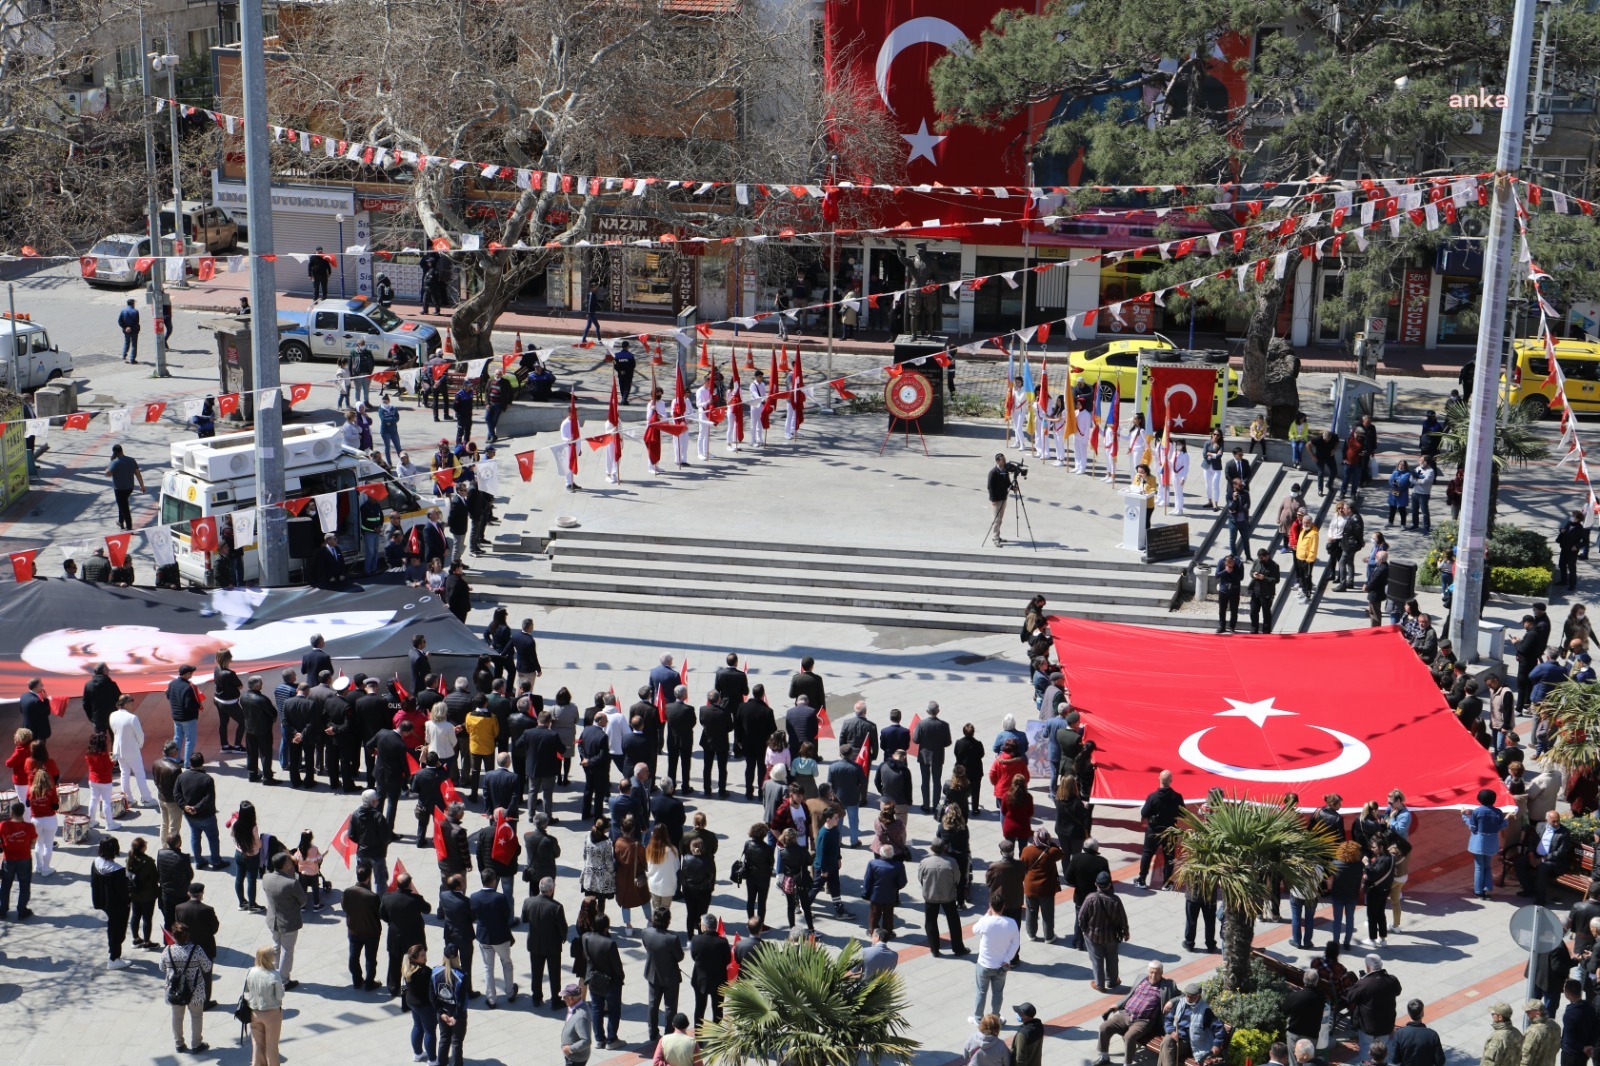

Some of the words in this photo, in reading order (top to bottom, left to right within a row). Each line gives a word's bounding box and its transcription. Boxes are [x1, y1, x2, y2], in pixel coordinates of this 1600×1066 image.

[271, 195, 349, 210] UYUMCULUK
[599, 217, 648, 232] NAZAR
[1409, 273, 1428, 282] SEMA
[681, 261, 692, 310] KUYUMCUL
[1132, 305, 1140, 315] 9
[1405, 283, 1425, 342] KUYMCULUK
[345, 342, 380, 350] ZAITA
